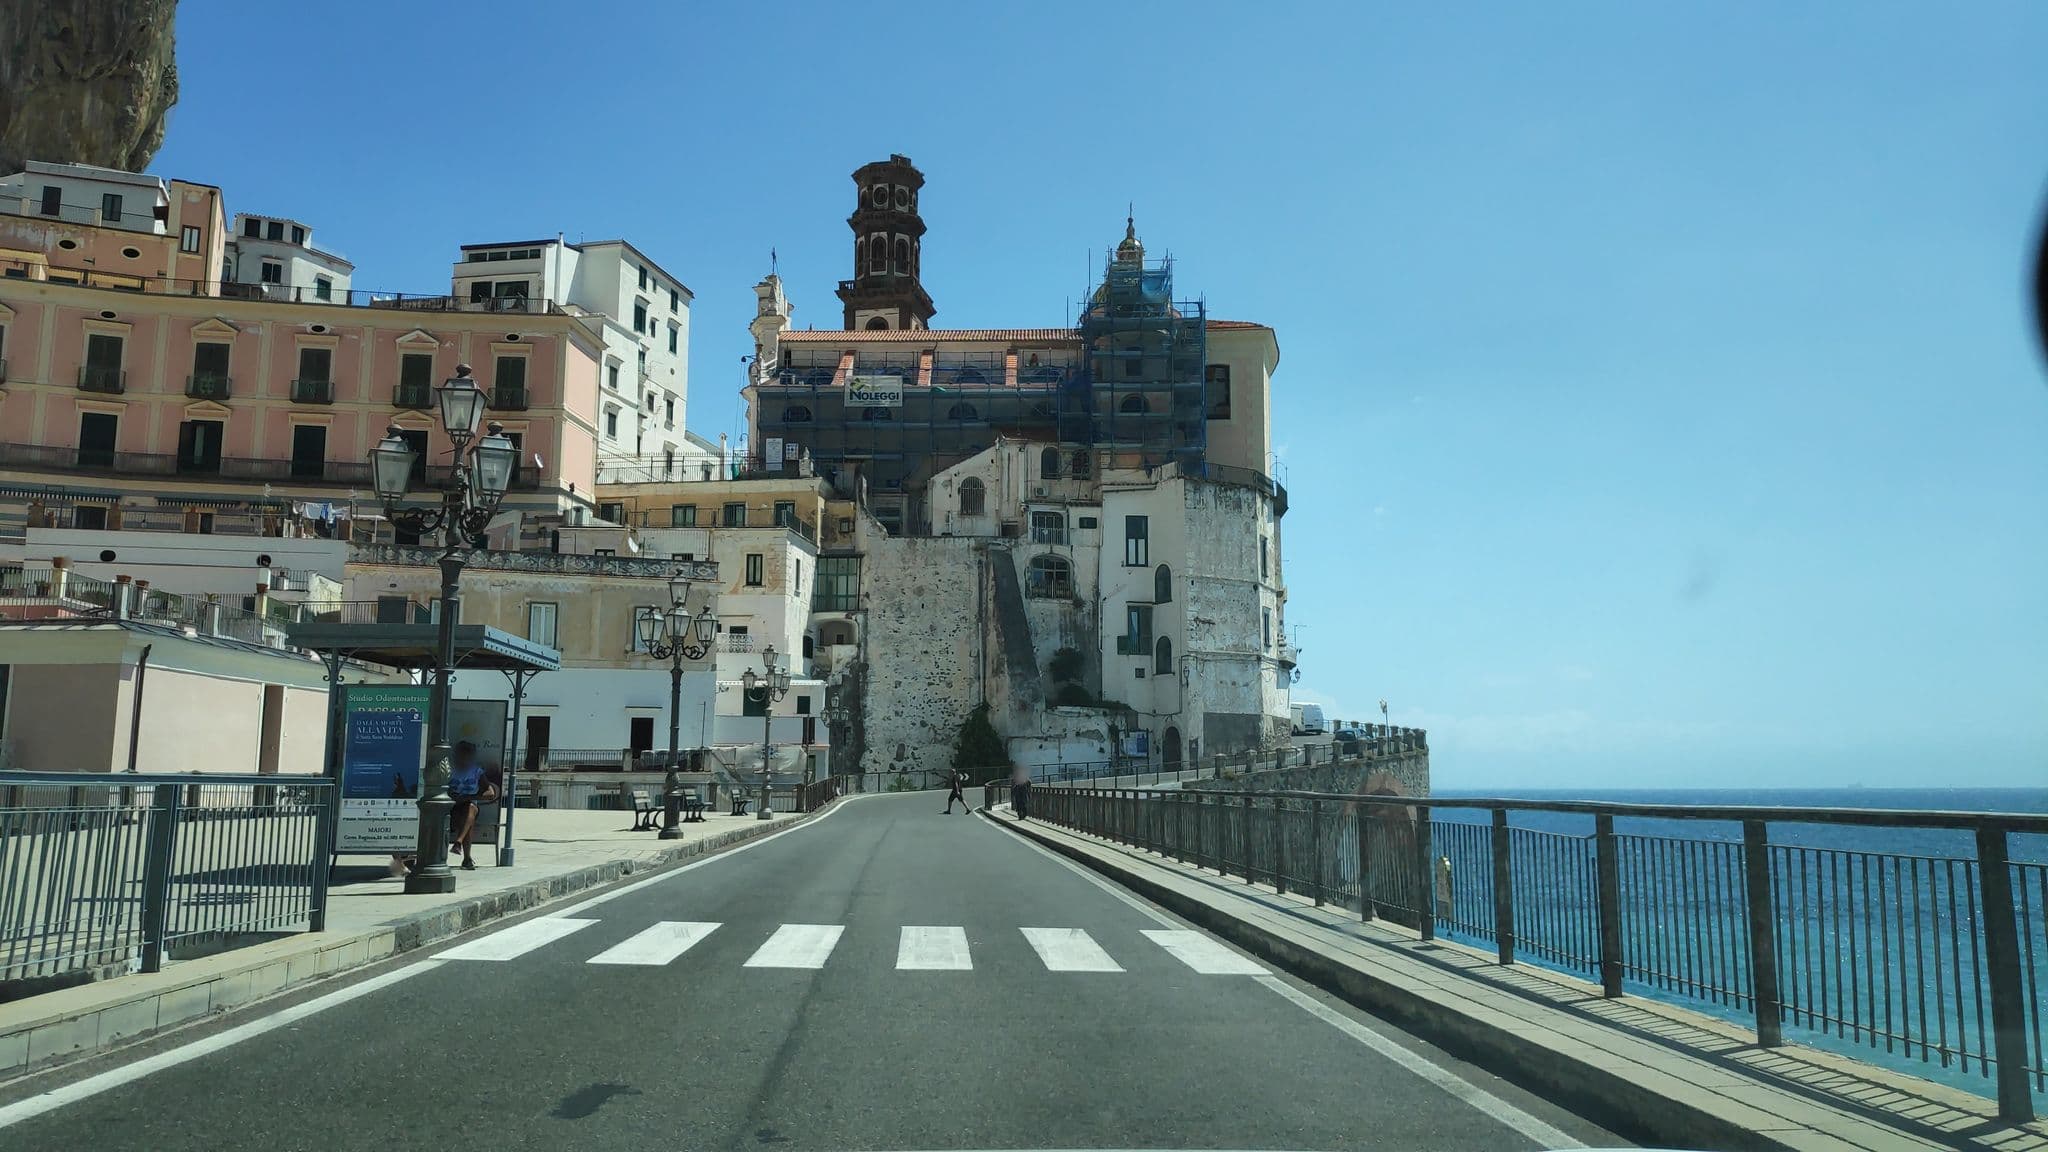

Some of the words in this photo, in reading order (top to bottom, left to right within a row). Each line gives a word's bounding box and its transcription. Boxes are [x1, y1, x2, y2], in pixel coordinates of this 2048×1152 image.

[849, 389, 899, 400] NOLEGGI
[348, 694, 373, 702] Studio
[375, 694, 429, 702] Odontoiatrico
